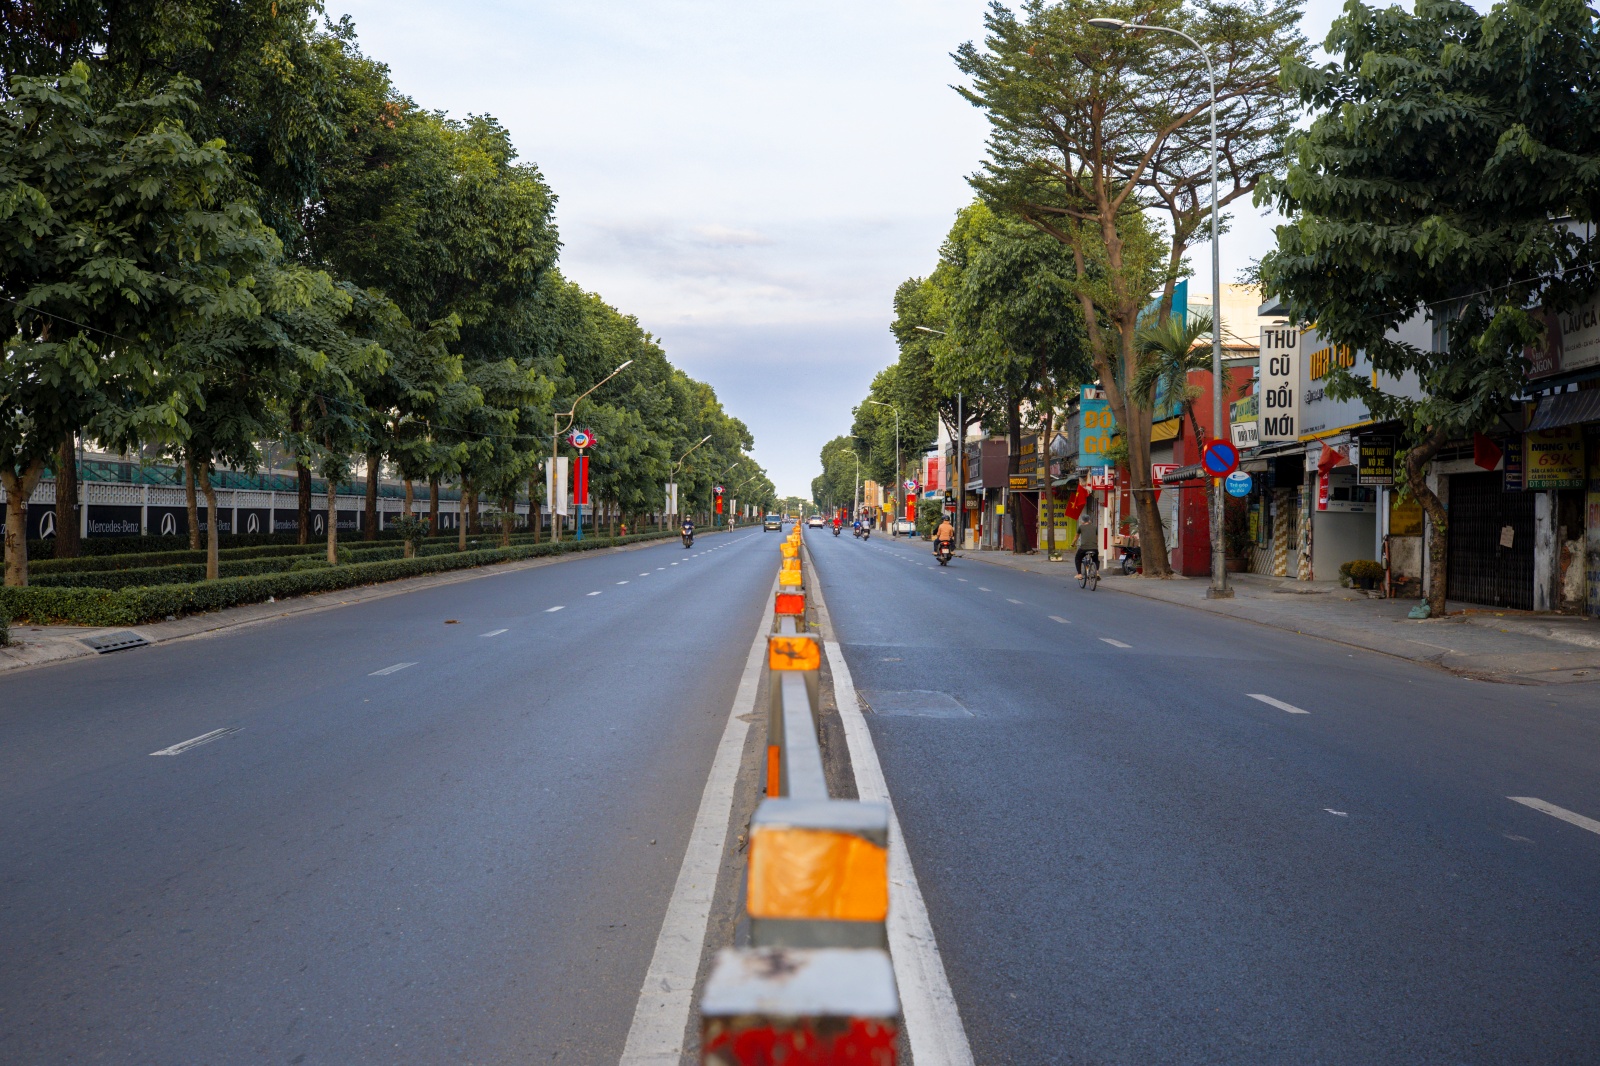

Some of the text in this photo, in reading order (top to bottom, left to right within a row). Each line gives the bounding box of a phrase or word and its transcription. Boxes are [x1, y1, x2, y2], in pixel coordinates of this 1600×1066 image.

[1583, 305, 1597, 329] CÁ
[1265, 330, 1296, 349] THU
[1269, 354, 1290, 376] CŨ
[1529, 358, 1553, 374] AIGON
[1266, 381, 1292, 408] ĐỔI
[1264, 413, 1294, 436] MỚI
[1361, 446, 1392, 456] THAY NHỚT
[1531, 443, 1564, 451] MANG
[1368, 456, 1385, 467] VỎ XE
[1538, 453, 1573, 466] 69K
[88, 519, 139, 533] Mercedes-Benz
